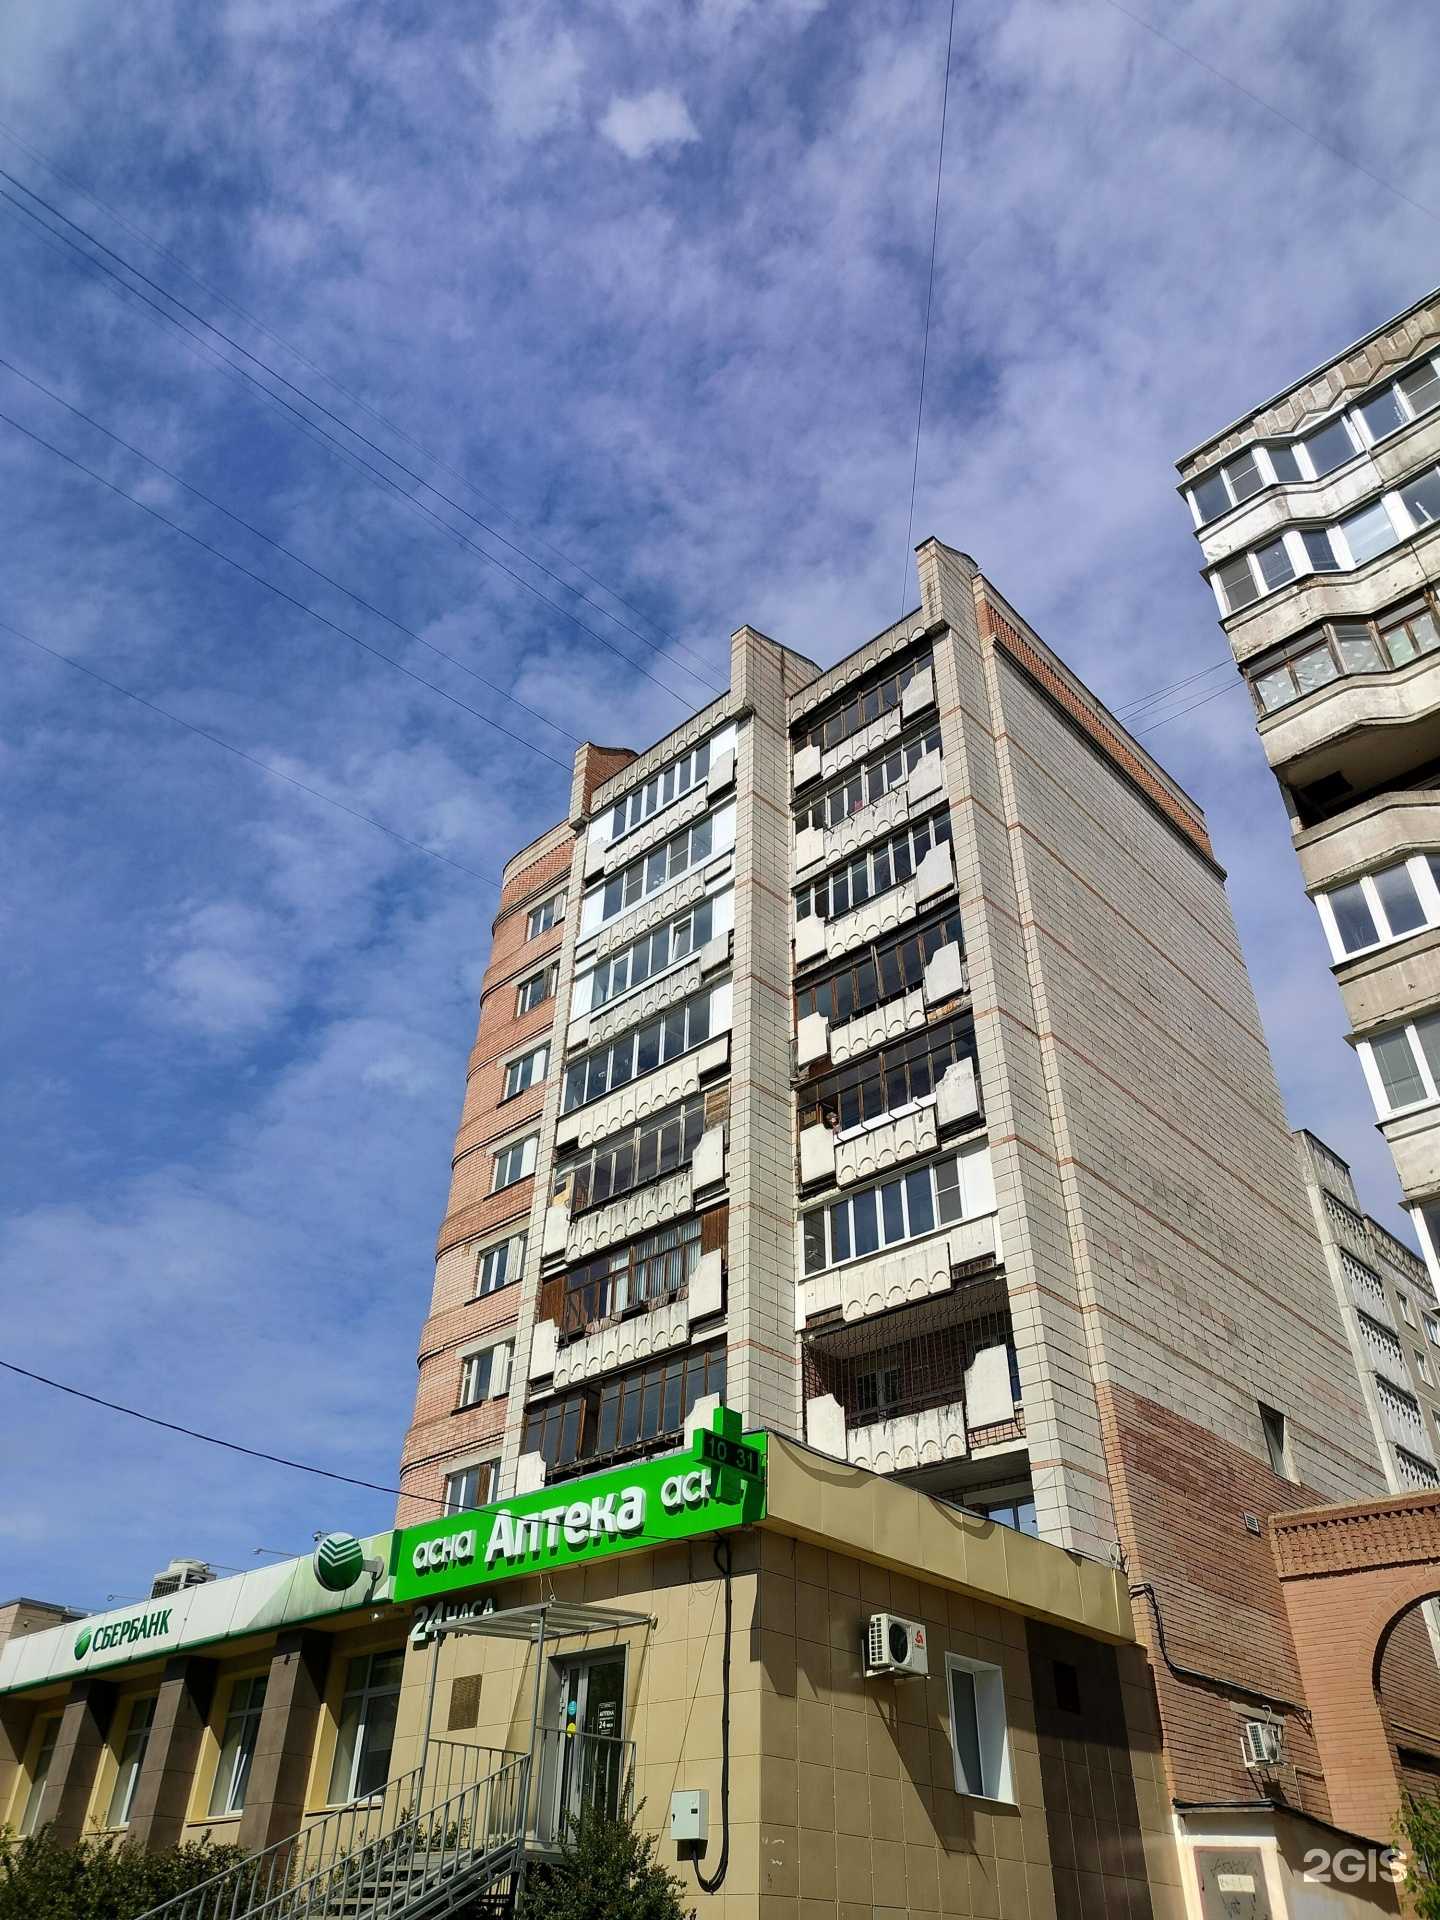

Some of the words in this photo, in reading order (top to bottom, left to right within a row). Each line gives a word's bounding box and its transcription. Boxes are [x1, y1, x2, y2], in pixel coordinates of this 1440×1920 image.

[412, 1529, 476, 1570] асна
[484, 1485, 647, 1563] Аптека
[92, 1608, 174, 1653] СБЕРБАНК
[410, 1600, 445, 1642] 24
